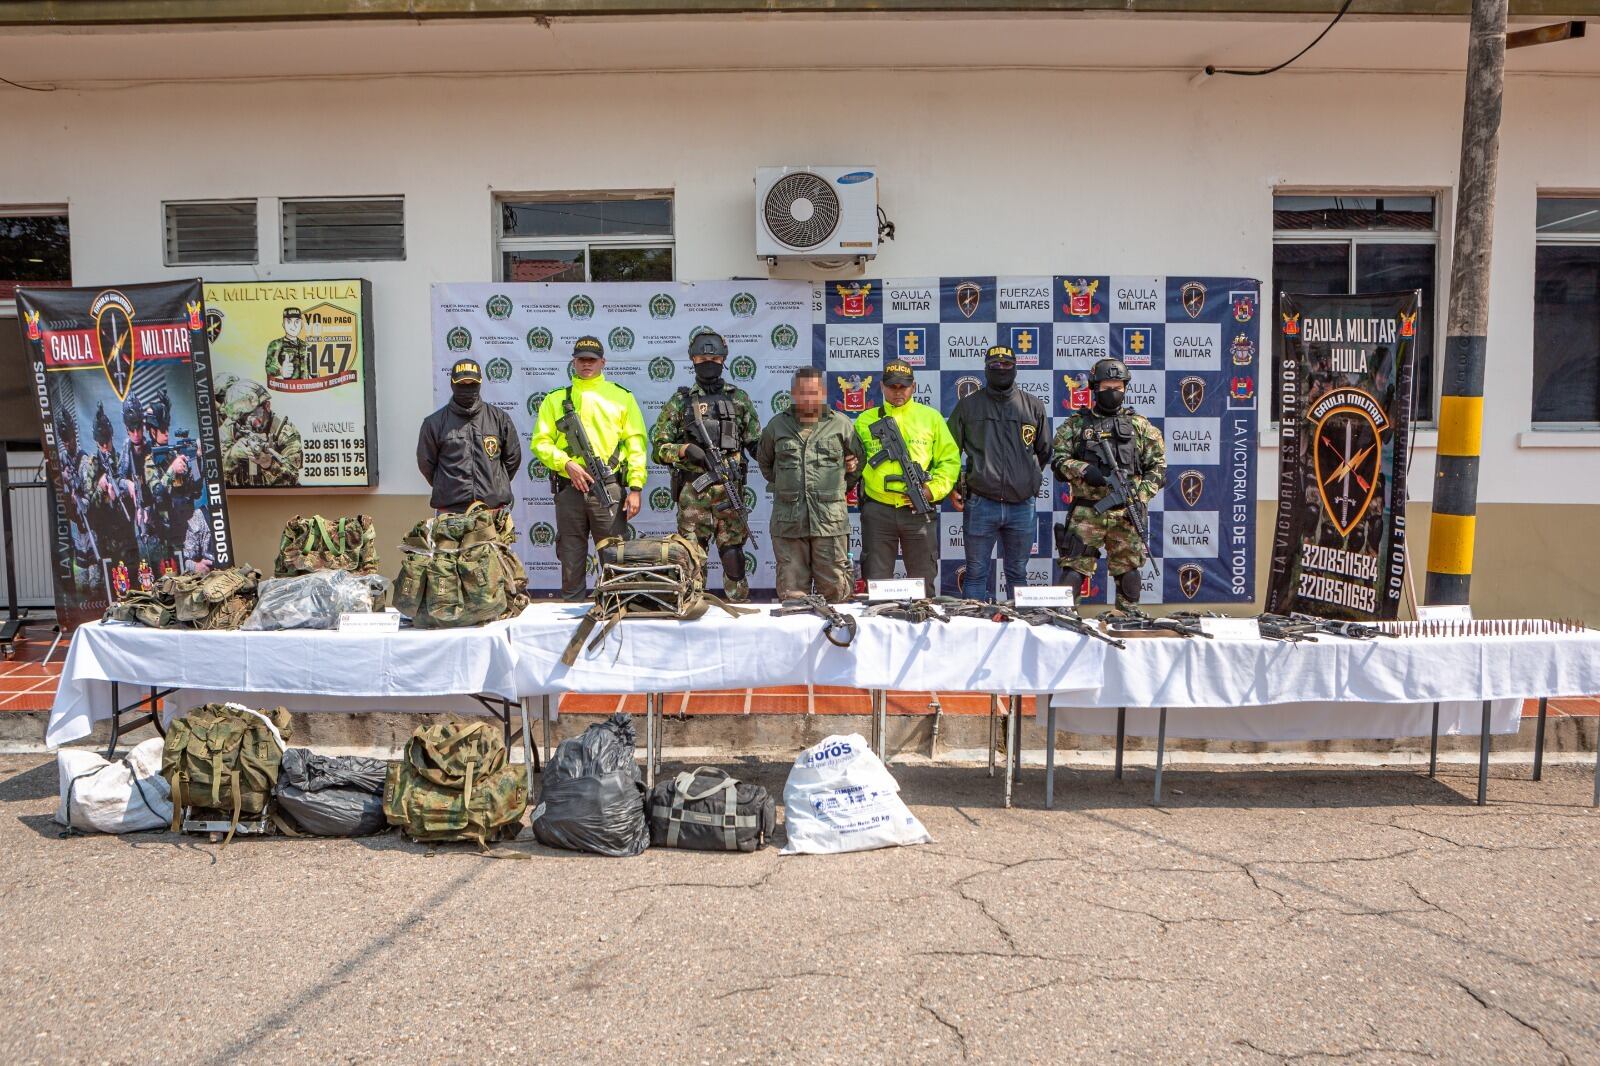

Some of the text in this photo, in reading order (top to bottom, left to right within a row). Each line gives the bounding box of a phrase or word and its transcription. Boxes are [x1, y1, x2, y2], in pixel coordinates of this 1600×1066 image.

[224, 288, 297, 301] MILITAR
[304, 286, 358, 300] HUILA
[890, 290, 932, 299] GAULA
[1000, 288, 1049, 298] FUERZAS
[1118, 289, 1158, 299] GAULA
[892, 301, 930, 310] MILITAR
[1000, 300, 1050, 310] MILITARES
[1118, 302, 1156, 310] MILITAR
[1304, 318, 1396, 343] GAULA MILITAR
[51, 328, 190, 360] GAULA MILITAR
[830, 337, 879, 346] FUERZAS
[948, 336, 988, 346] GAULA
[1056, 335, 1106, 345] FUERZAS
[1173, 337, 1213, 346] GAULA
[829, 350, 880, 358] MILITARES
[949, 348, 986, 358] MILITAR
[1056, 348, 1106, 357] MILITARES
[1174, 348, 1211, 358] MILITAR
[307, 344, 351, 374] 147
[1332, 348, 1368, 373] HUILA
[34, 361, 50, 420] TODOS
[1126, 384, 1157, 393] AULA
[1124, 396, 1155, 404] ILITAR
[1314, 393, 1383, 425] GAULA MILITAR
[312, 422, 355, 433] MARQUE
[43, 424, 54, 444] DE
[1172, 431, 1212, 441] GAULA
[304, 439, 364, 449] 320 851 16 93
[1173, 443, 1210, 452] MILITAR
[193, 352, 228, 564] LA VICTORIA ES DE TODOS
[305, 452, 364, 463] 320 851 15 75
[304, 466, 366, 477] 320 851 15 84
[1274, 360, 1295, 574] LA VICTORIA ES DE TODOS
[1232, 419, 1248, 595] LA VICTORIA ES DE TODOS
[1171, 524, 1211, 534] GAULA
[1395, 516, 1405, 536] DE
[1172, 536, 1208, 545] MILITAR
[1302, 544, 1378, 581] 3208511584
[60, 558, 71, 578] LA
[1389, 544, 1404, 600] TODOS
[1298, 573, 1376, 613] 3208511693
